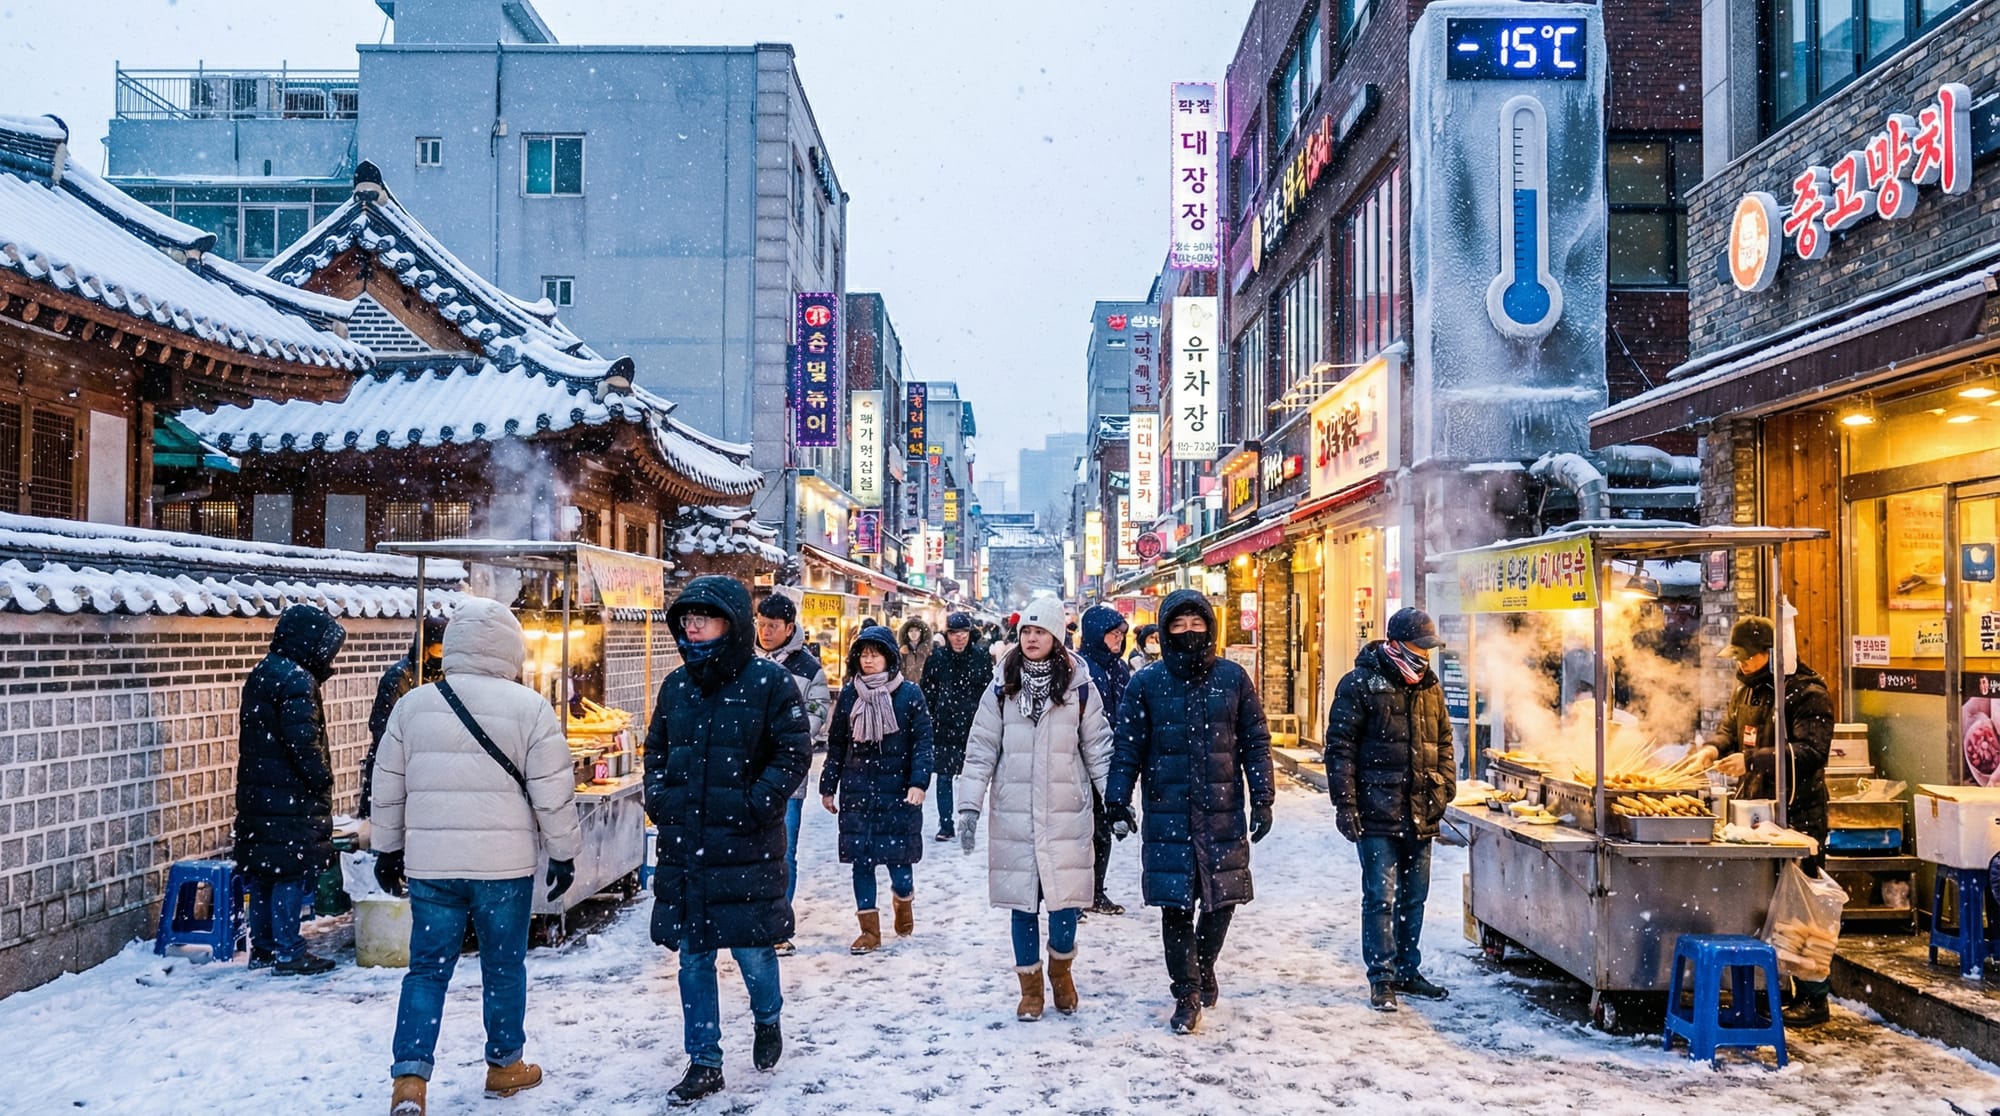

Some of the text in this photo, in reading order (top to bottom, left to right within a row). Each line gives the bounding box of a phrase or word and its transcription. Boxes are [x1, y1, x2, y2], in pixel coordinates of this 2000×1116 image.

[1180, 130, 1209, 231] 대장장
[1783, 86, 1956, 260] 중고망치
[1182, 335, 1210, 432] 유차장
